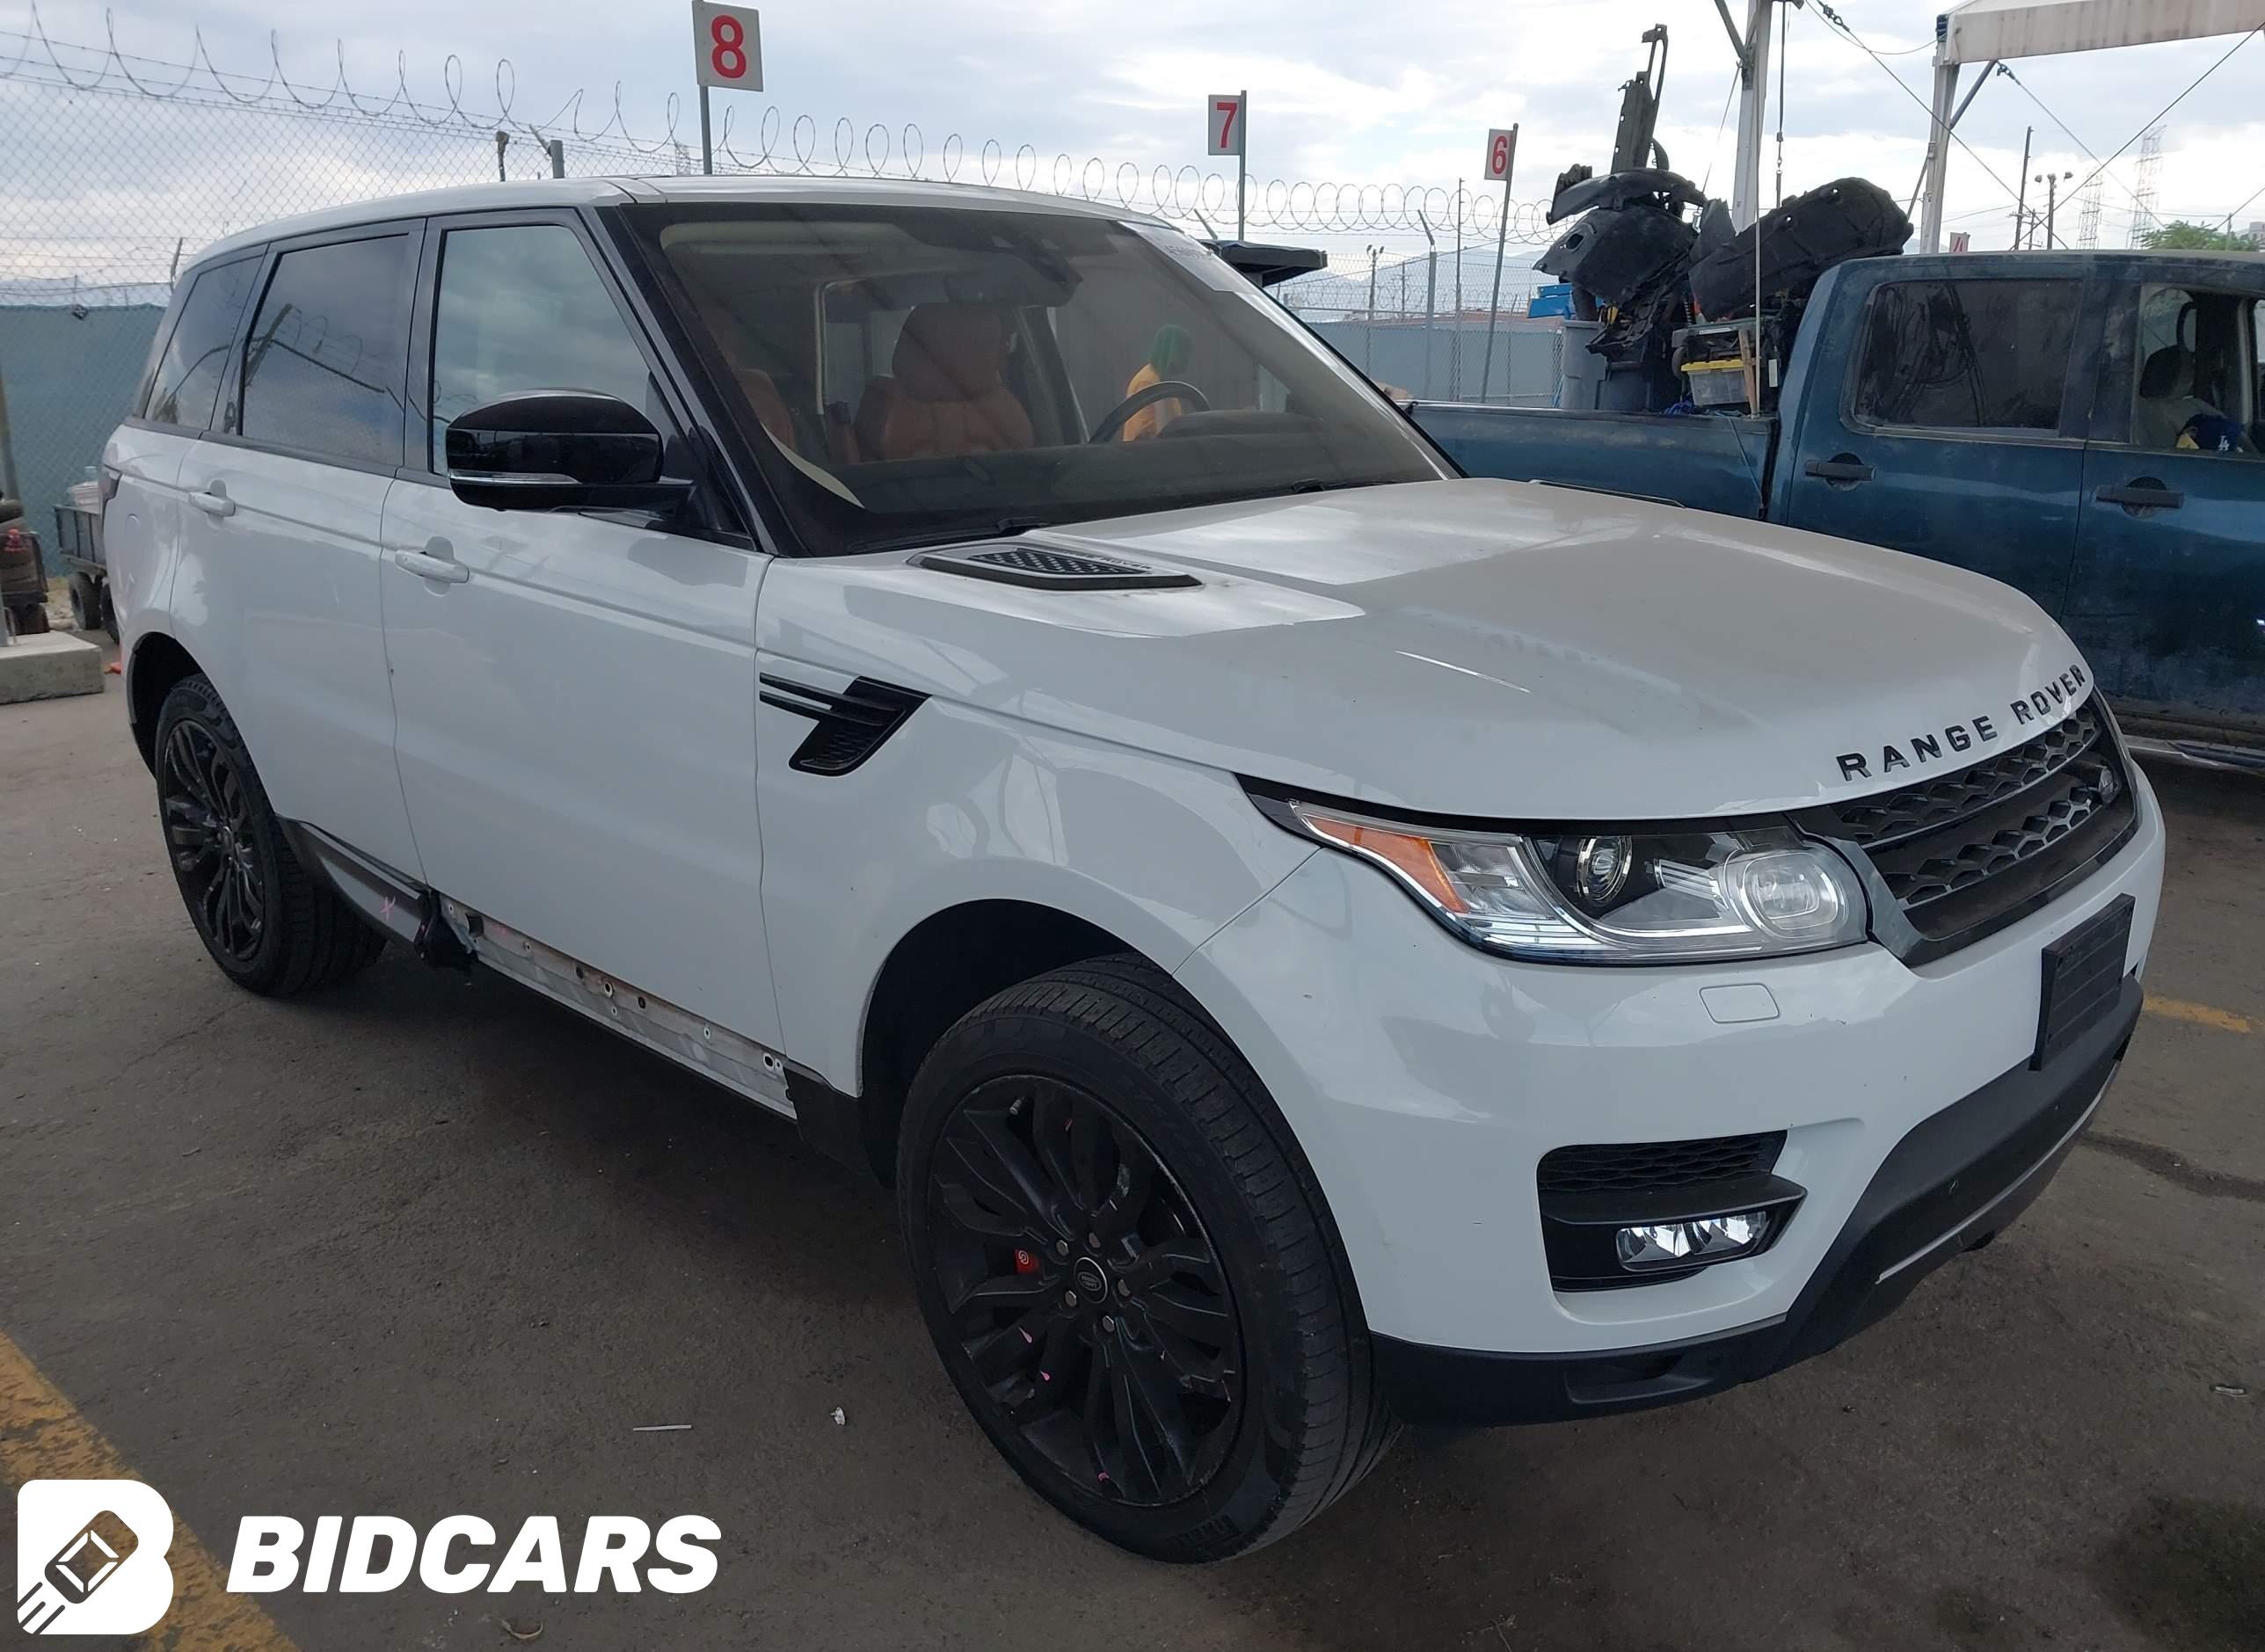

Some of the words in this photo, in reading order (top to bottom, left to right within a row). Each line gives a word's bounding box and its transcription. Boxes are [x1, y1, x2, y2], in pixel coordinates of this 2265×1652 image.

[711, 14, 747, 79] 8
[1216, 101, 1238, 149] 7
[1491, 135, 1508, 175] 6
[1836, 715, 1998, 782] RANGE
[2009, 664, 2086, 725] ROVER
